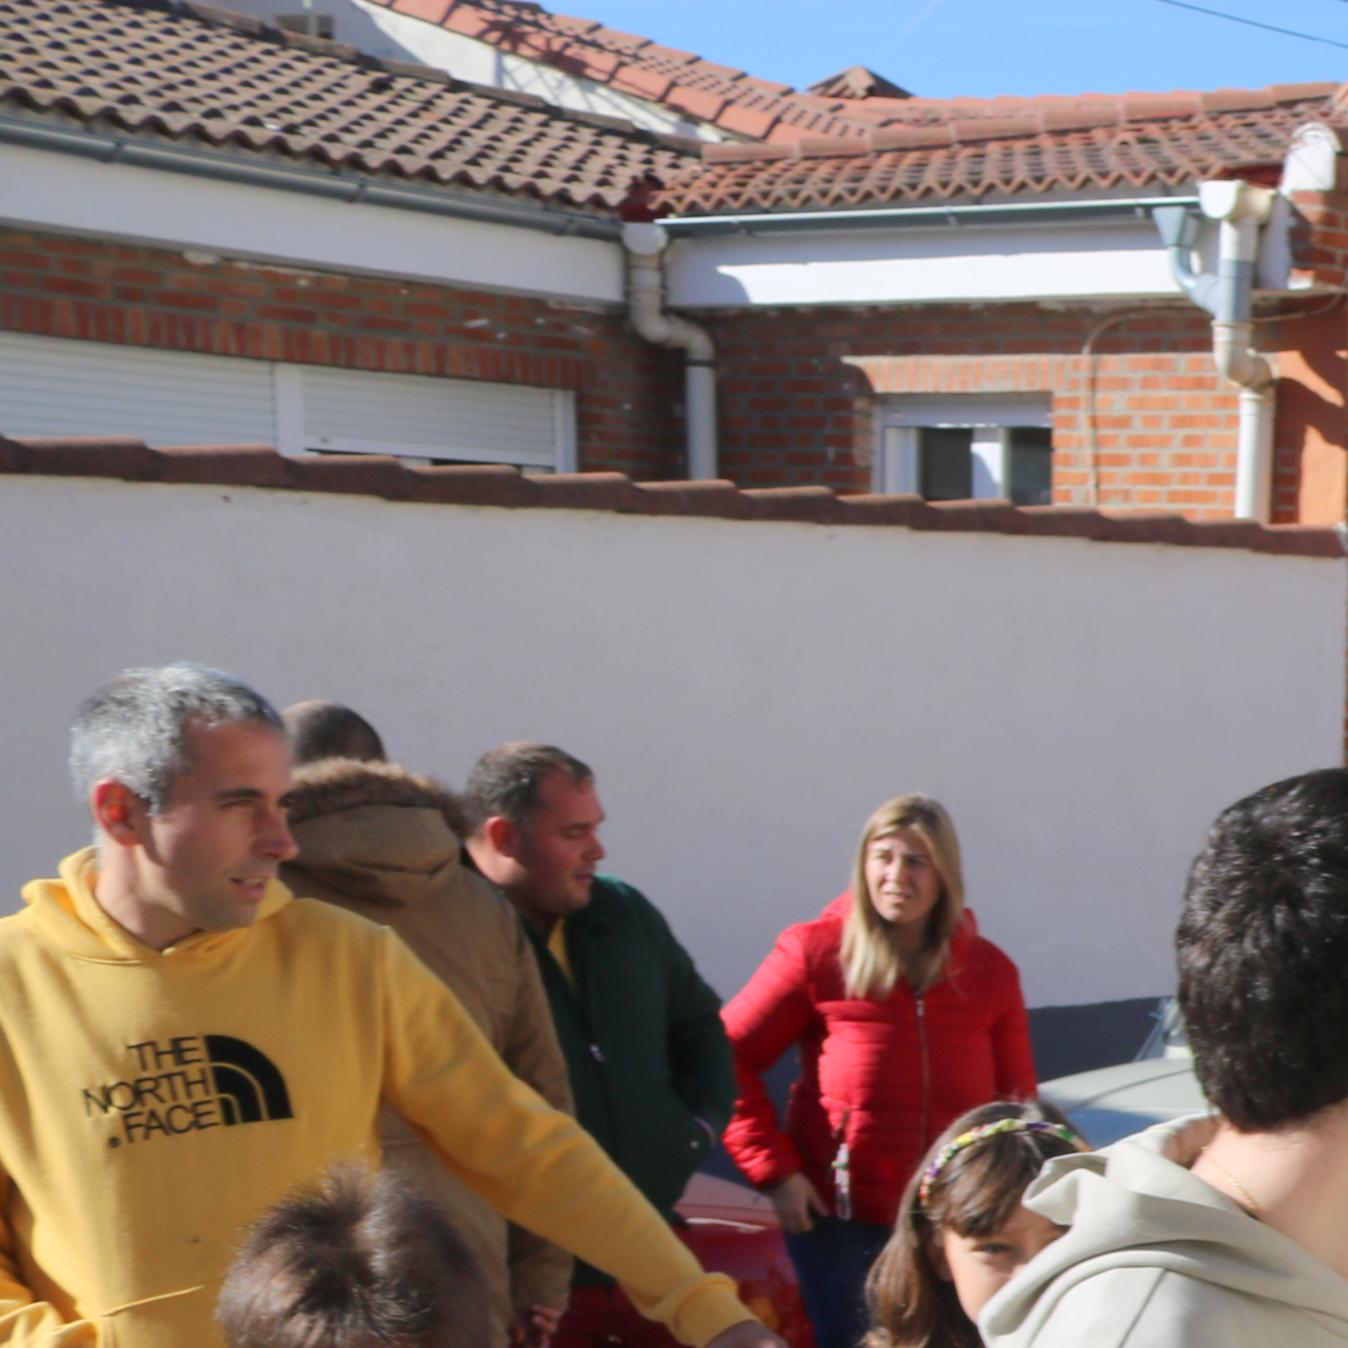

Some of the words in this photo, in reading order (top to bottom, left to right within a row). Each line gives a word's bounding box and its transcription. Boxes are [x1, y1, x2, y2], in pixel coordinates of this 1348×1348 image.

[126, 1036, 204, 1072] THE
[82, 1068, 211, 1118] NORTH
[122, 1100, 221, 1144] FACE
